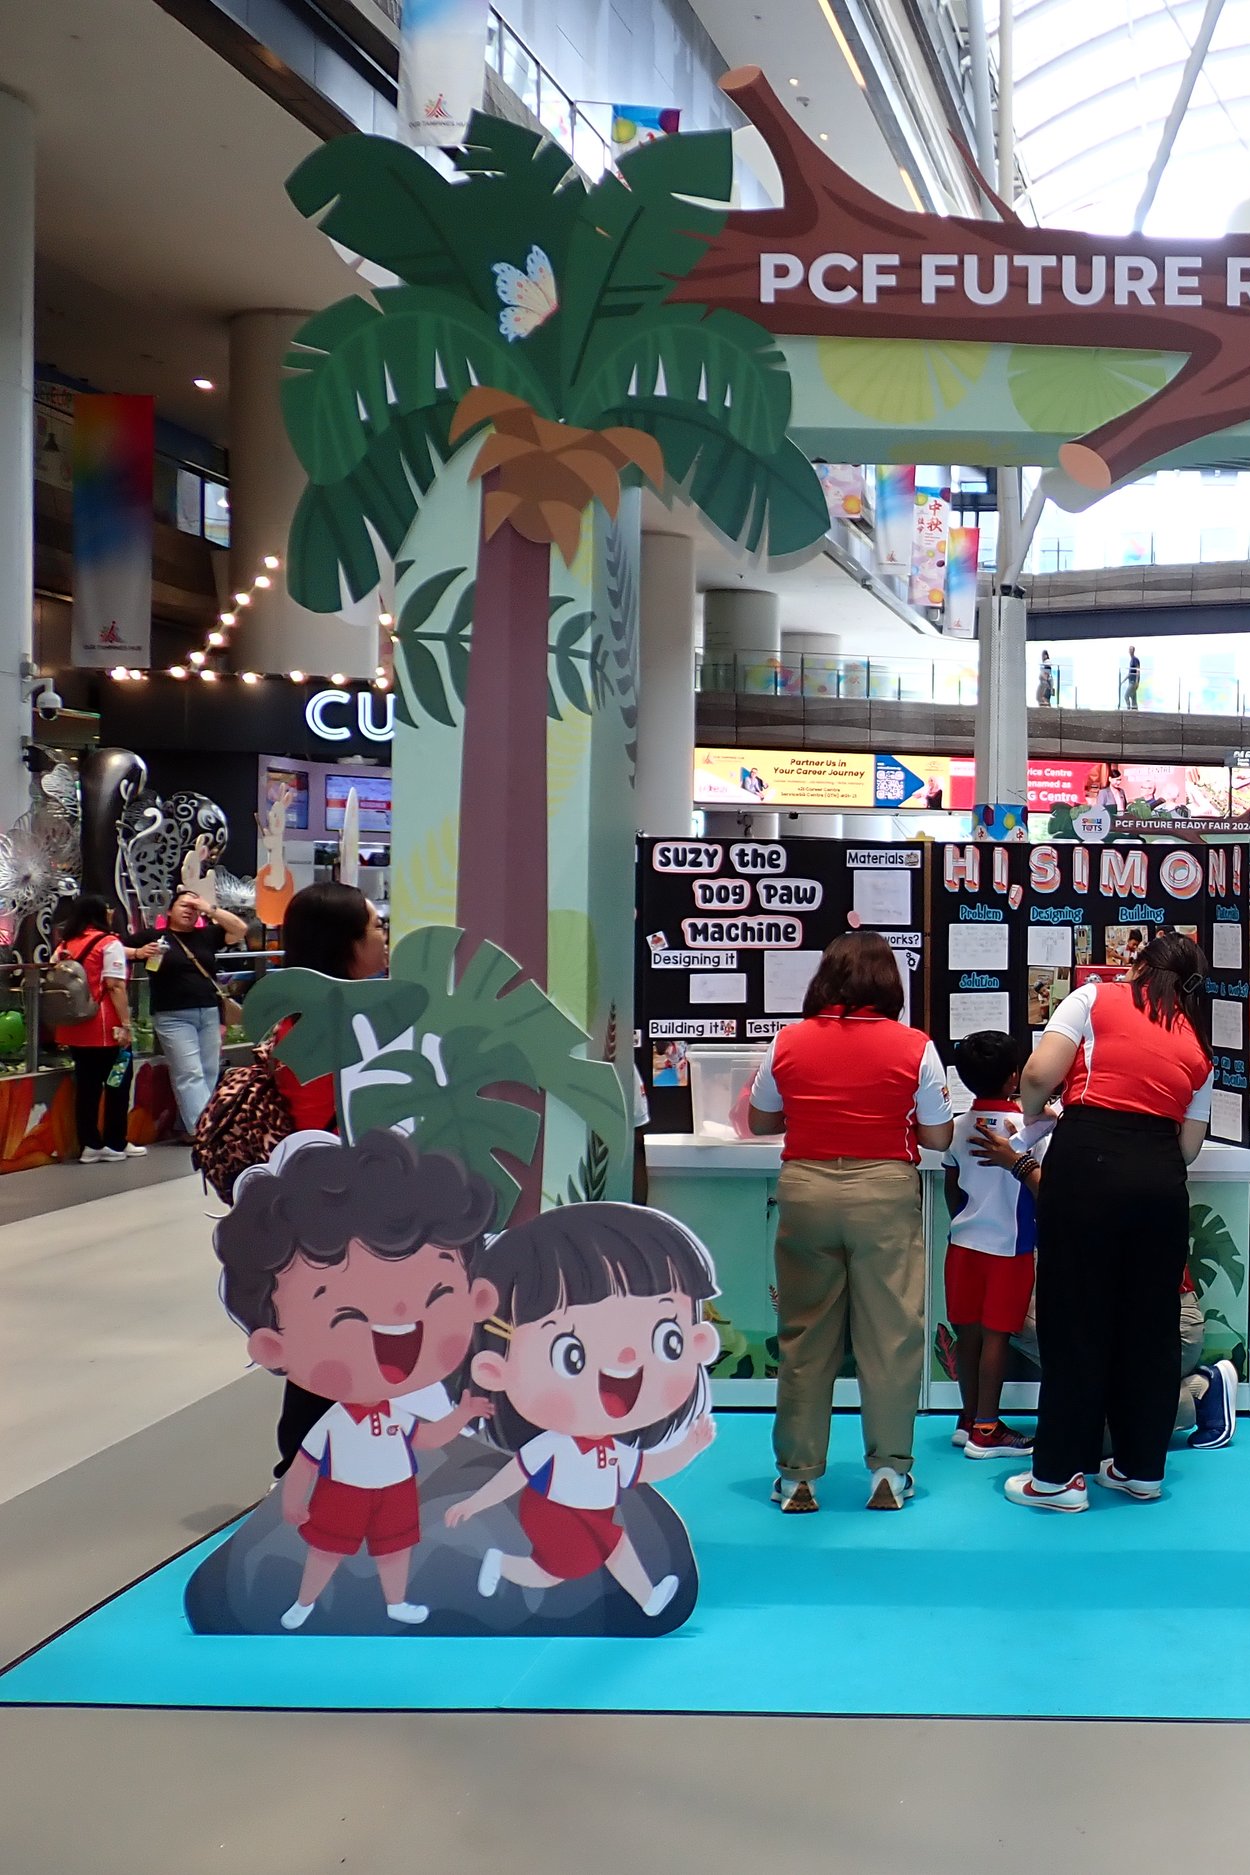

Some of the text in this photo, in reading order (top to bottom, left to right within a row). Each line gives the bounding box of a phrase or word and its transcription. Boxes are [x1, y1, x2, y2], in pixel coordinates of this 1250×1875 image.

[760, 253, 900, 305] PCF
[921, 254, 1203, 306] FUTURE
[927, 499, 942, 533] 中秋
[305, 689, 396, 741] CU
[790, 758, 847, 768] Partner Us in
[773, 767, 865, 779] Your Career Journey
[1043, 768, 1072, 777] Centre
[1038, 791, 1078, 802] Centre
[1115, 820, 1134, 828] PCF
[1136, 820, 1173, 829] FUTURE
[1174, 821, 1207, 830] READY
[1208, 821, 1230, 831] FAIR
[658, 847, 781, 869] SUZY the
[848, 852, 904, 865] Materials
[1029, 845, 1242, 900] SIMON!
[960, 903, 1003, 921] Problem
[1030, 906, 1083, 924] Designing
[1119, 903, 1165, 923] Building
[653, 953, 735, 967] Designing it
[959, 972, 999, 989] Solution
[651, 1022, 719, 1036] Building it
